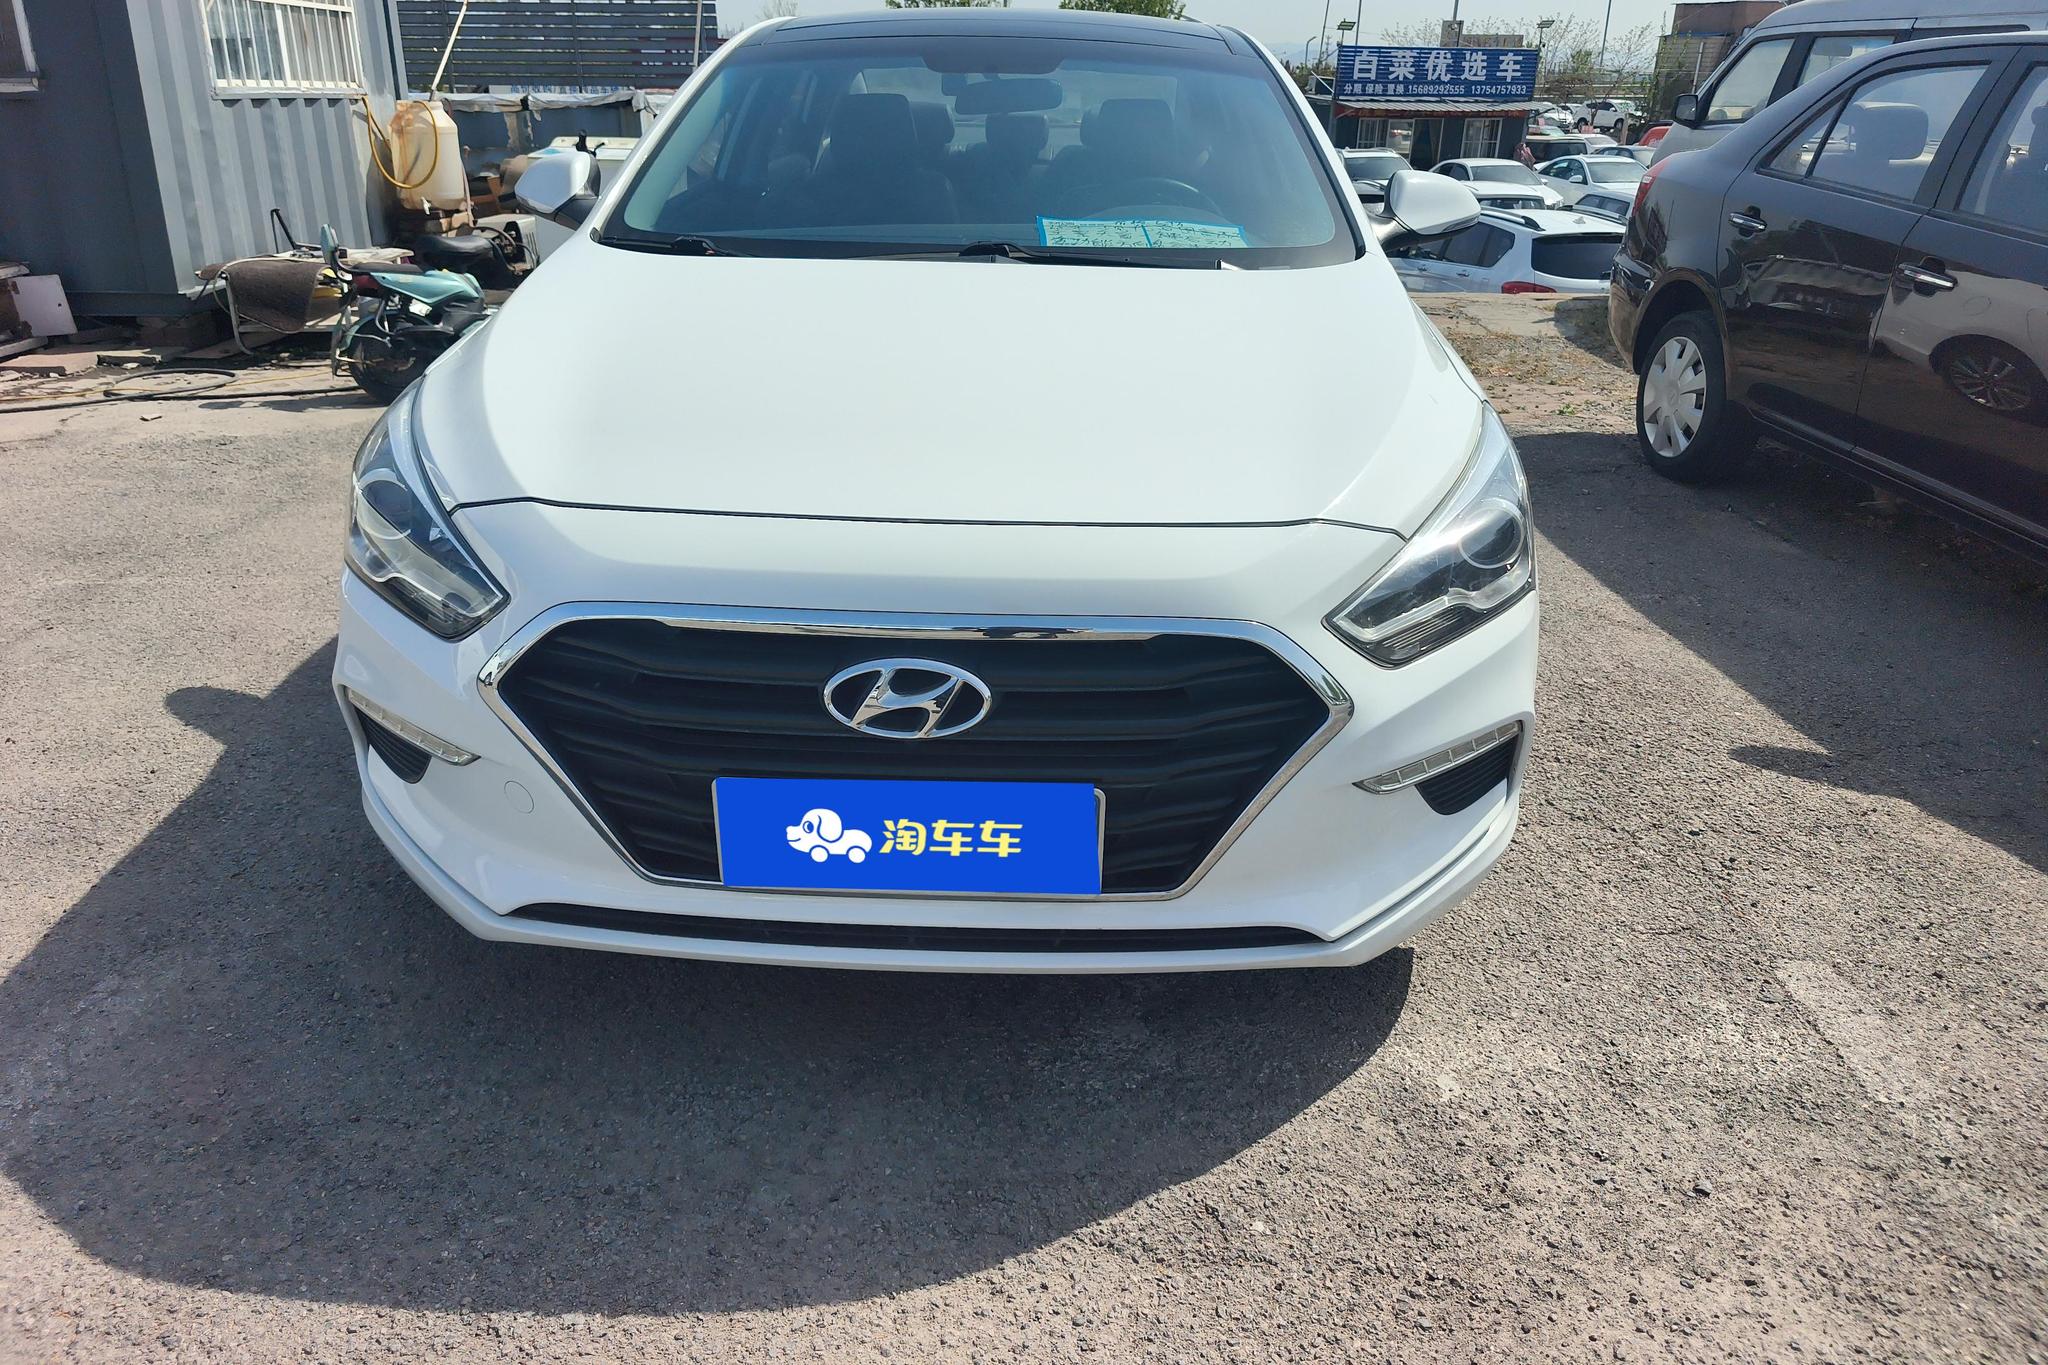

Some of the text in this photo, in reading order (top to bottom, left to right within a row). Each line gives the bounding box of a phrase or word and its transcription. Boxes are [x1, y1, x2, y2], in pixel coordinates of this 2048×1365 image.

[1366, 83, 1383, 95] 保险
[1387, 83, 1404, 95] 置换
[1408, 85, 1465, 95] 15689292555
[1471, 85, 1527, 95] 13754757933
